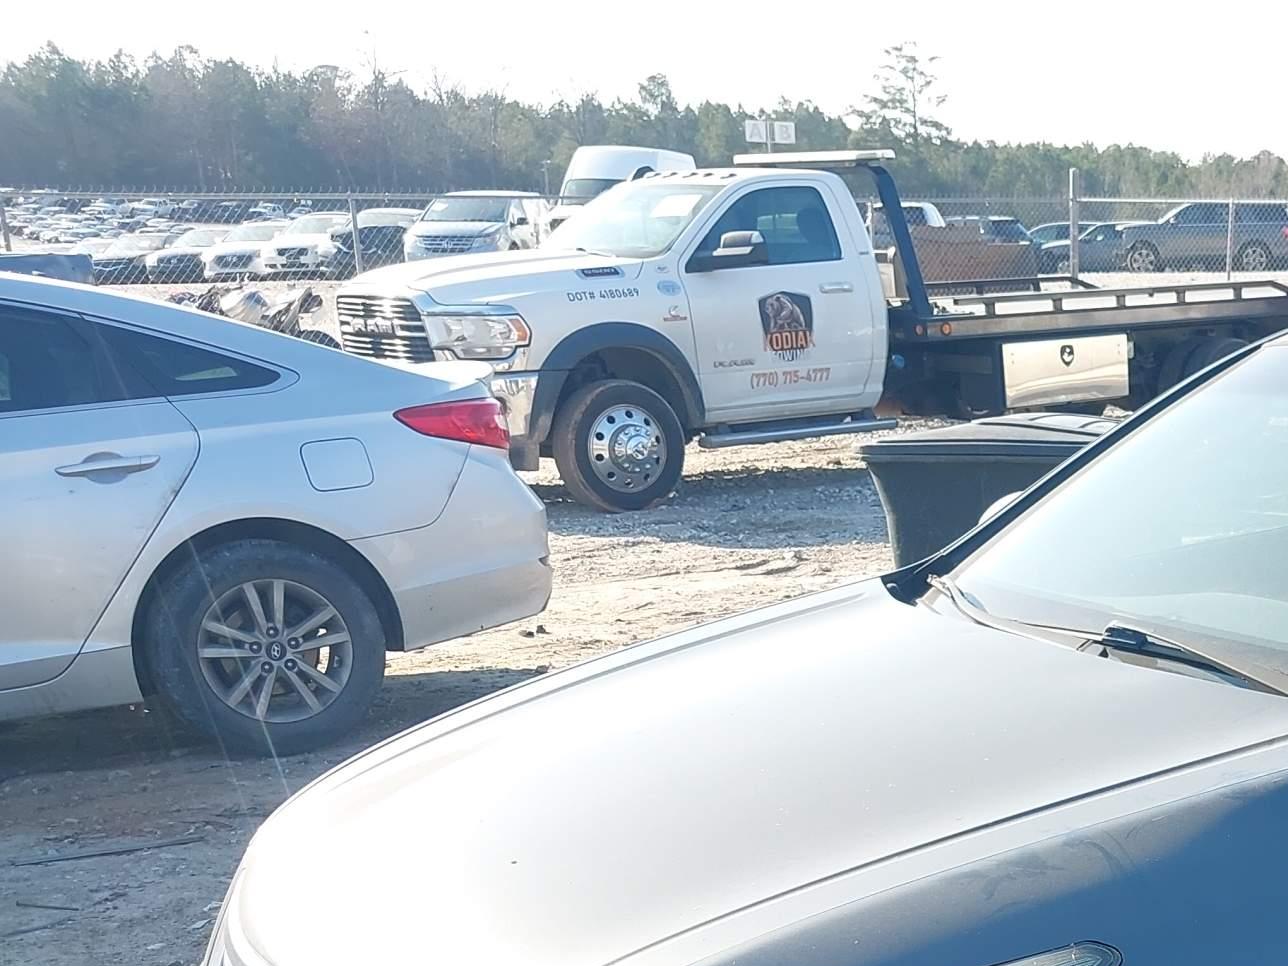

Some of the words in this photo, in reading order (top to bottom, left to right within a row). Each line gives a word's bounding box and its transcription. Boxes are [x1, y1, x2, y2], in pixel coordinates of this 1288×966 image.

[566, 291, 596, 303] DOT#
[599, 287, 640, 300] 4180689
[762, 330, 816, 352] KODIAK
[750, 370, 779, 390] (770)
[782, 367, 831, 385] 715-4777
